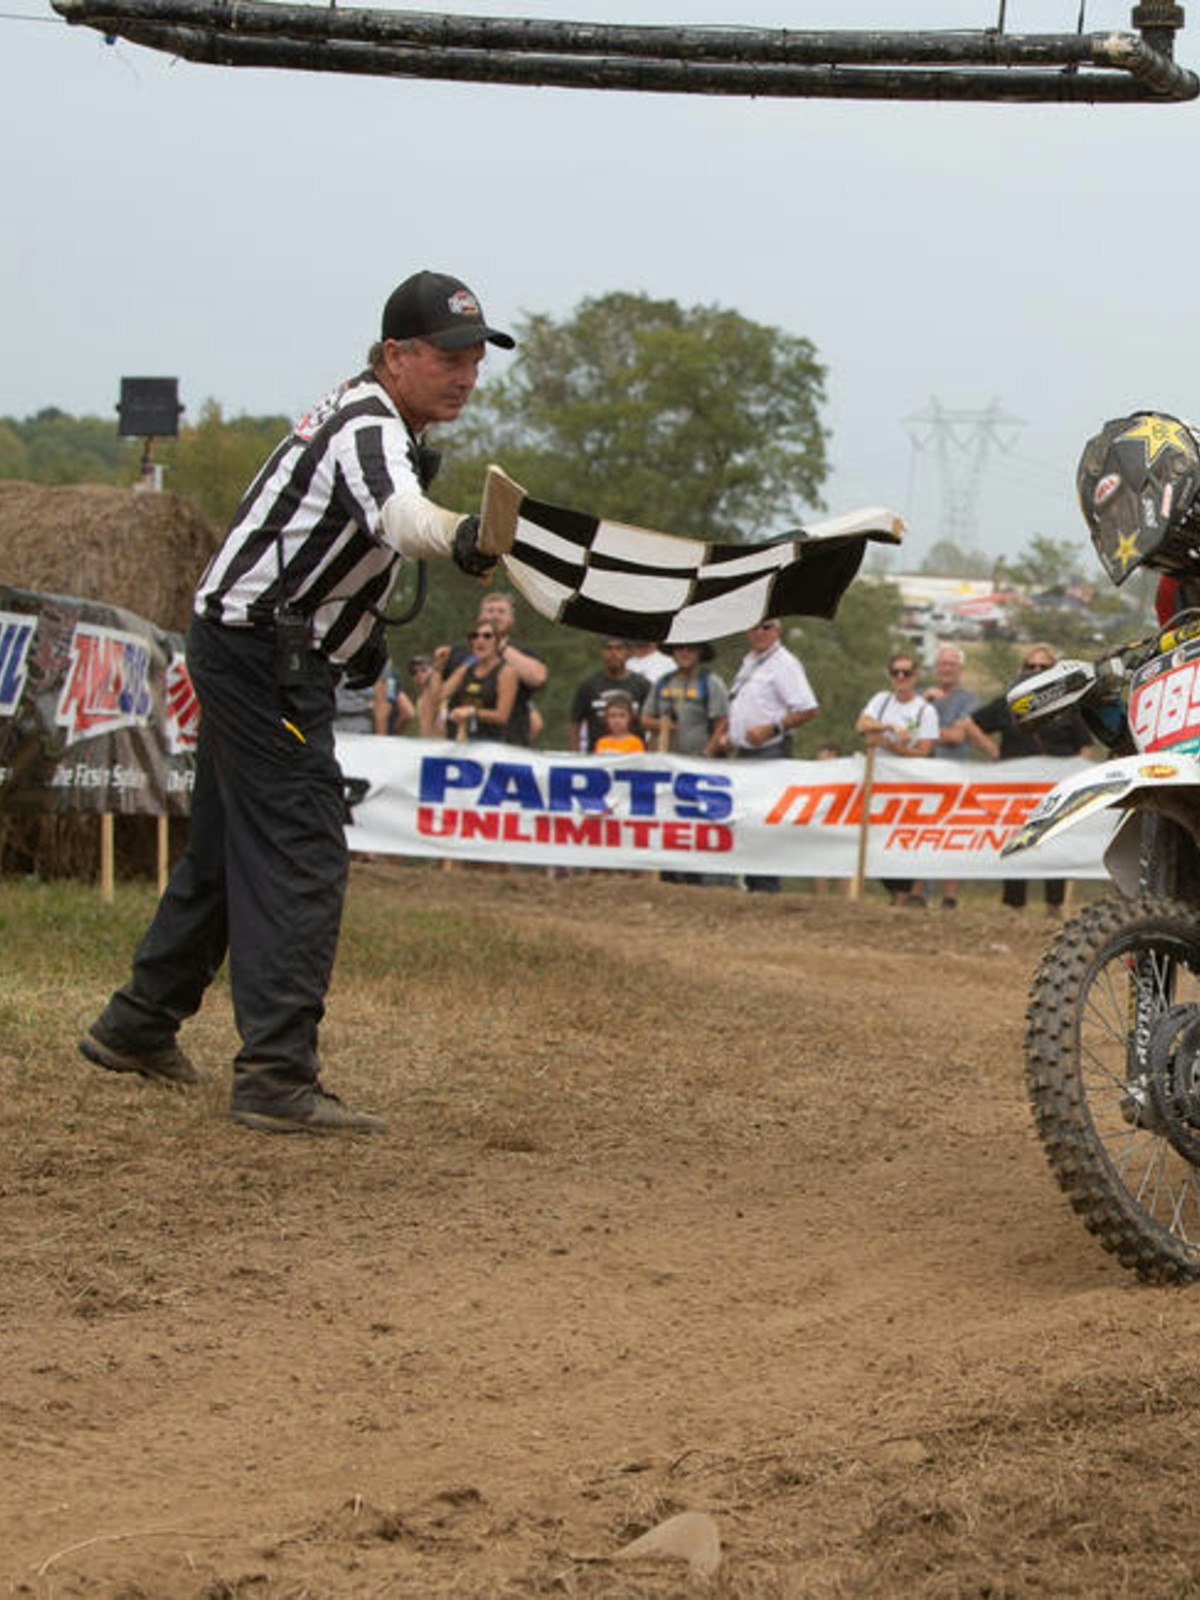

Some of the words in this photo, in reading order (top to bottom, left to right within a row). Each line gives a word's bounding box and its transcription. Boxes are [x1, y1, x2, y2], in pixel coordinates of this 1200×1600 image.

[419, 757, 733, 820] PARTS
[764, 782, 1058, 826] MOOSE
[416, 807, 734, 853] UNLIMITED
[884, 828, 1012, 851] RACIN
